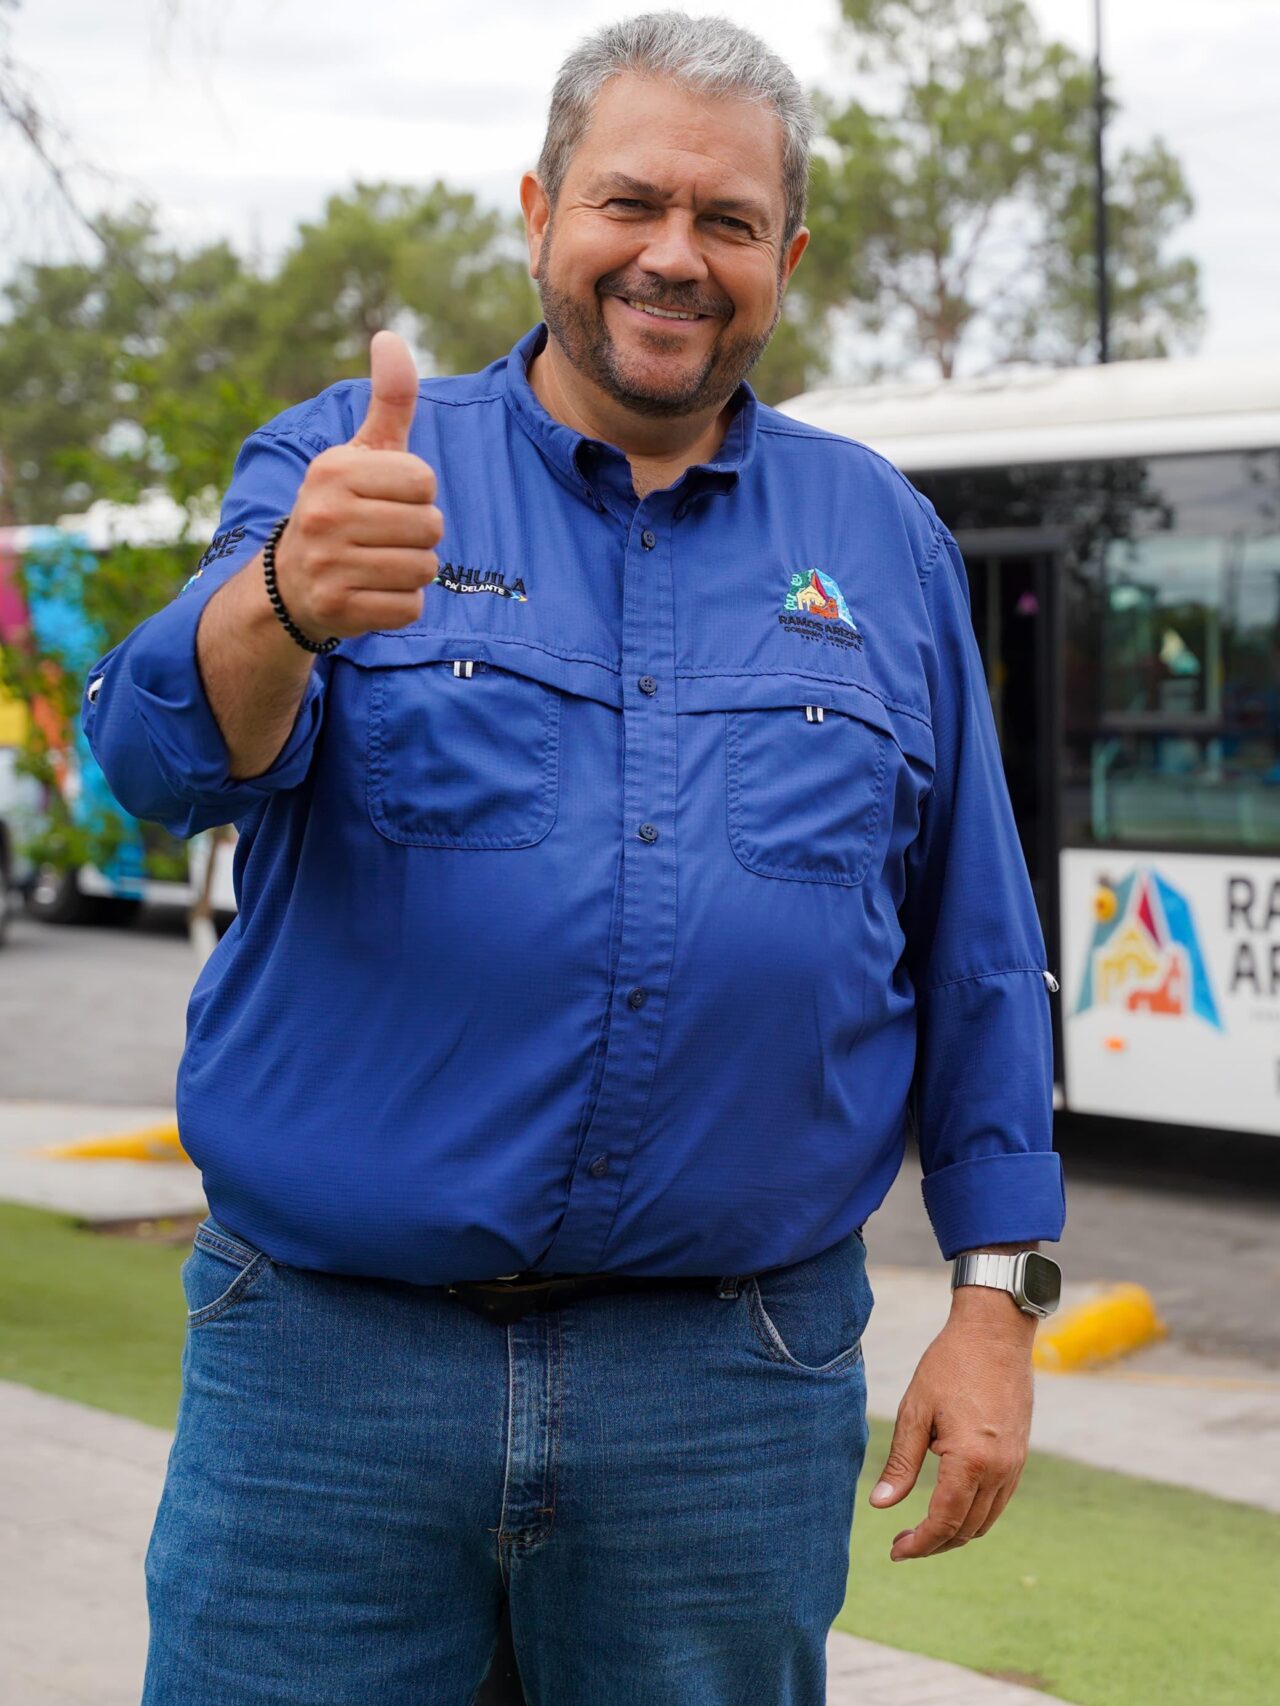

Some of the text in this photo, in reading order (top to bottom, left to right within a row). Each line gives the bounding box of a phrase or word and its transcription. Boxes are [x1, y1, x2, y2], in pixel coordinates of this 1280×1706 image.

[438, 563, 527, 595] AHUILA
[460, 584, 505, 596] DELANTE
[778, 615, 824, 632] RAMOS
[824, 624, 864, 646] ARIZPE
